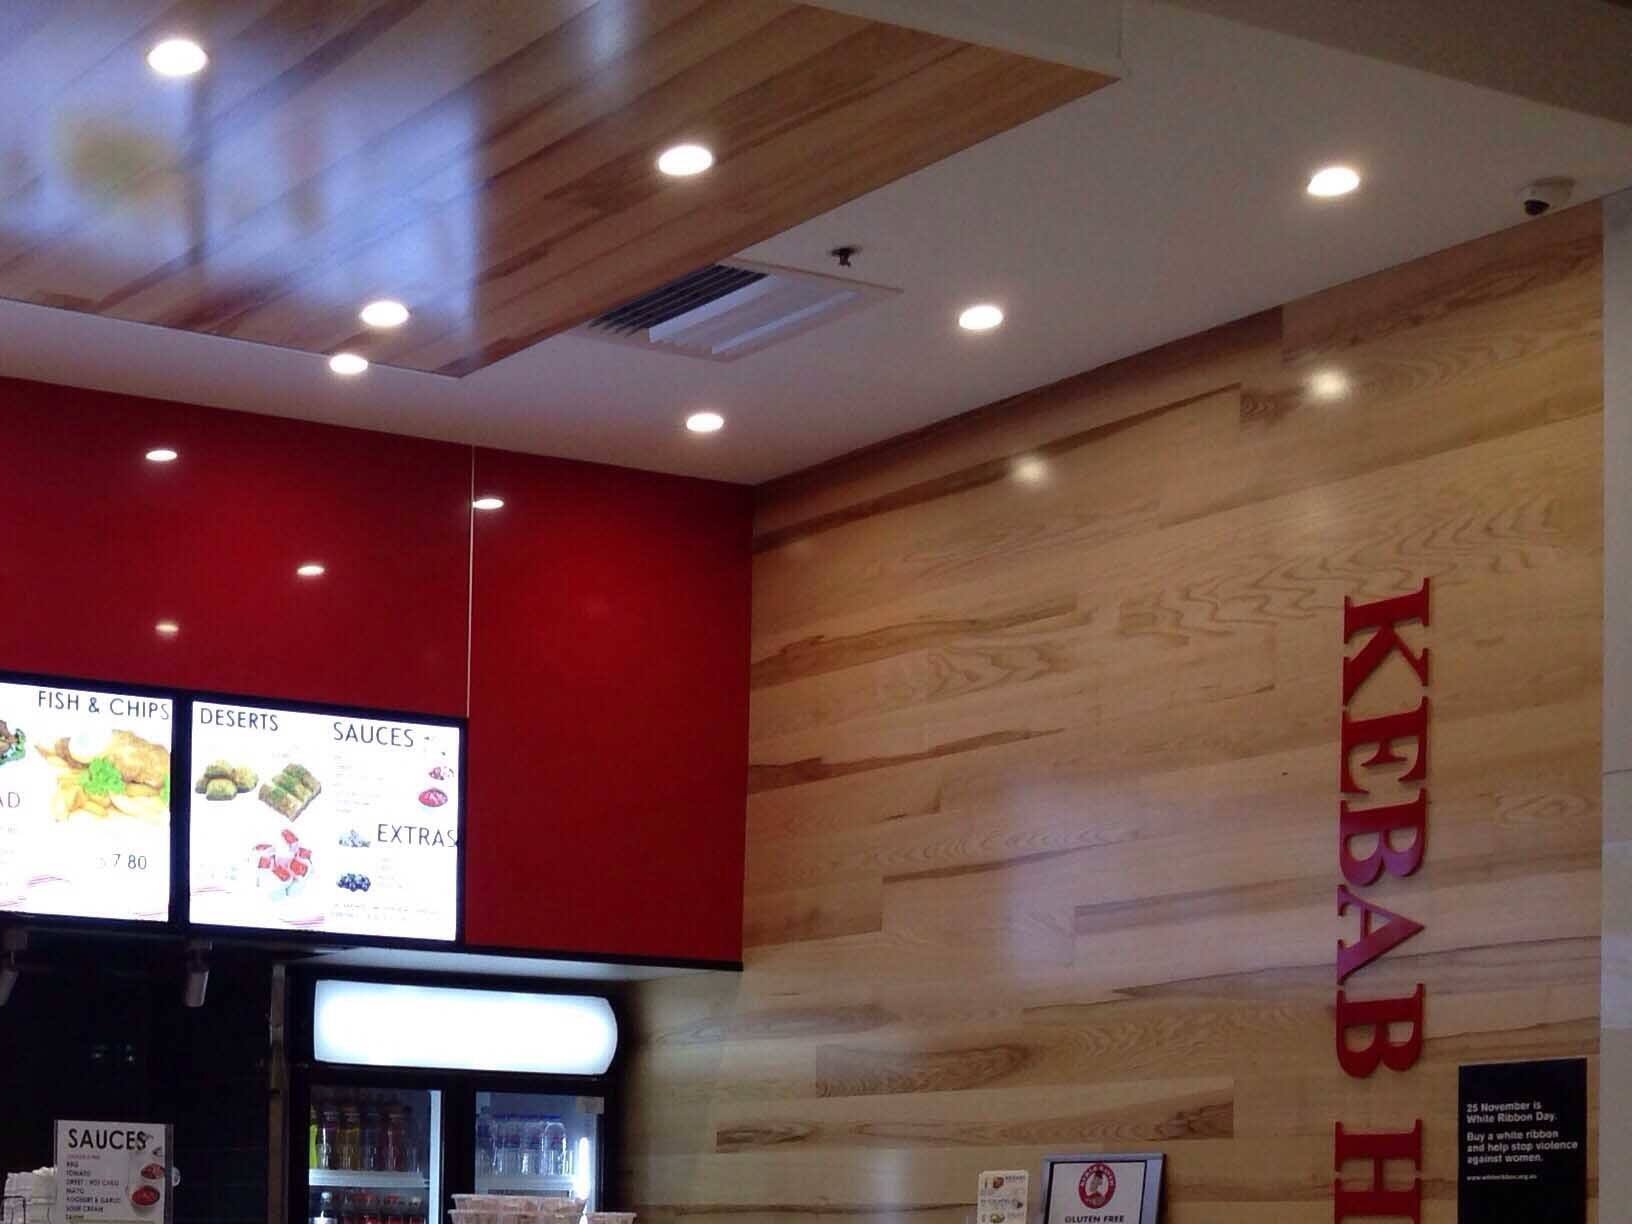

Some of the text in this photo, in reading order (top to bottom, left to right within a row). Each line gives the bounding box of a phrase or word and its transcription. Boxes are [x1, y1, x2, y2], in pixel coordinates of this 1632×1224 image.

[38, 690, 169, 721] FISH & CHIPS
[200, 707, 279, 732] DESERTS
[333, 721, 414, 748] SAUCES
[377, 823, 458, 848] EXTRAS
[1335, 577, 1430, 1079] KEBAB
[1466, 1101, 1542, 1112] 25 November is
[1466, 1114, 1494, 1123] White
[1497, 1112, 1533, 1122] Ribbon
[68, 1128, 146, 1151] SAUCES
[1466, 1132, 1485, 1142] Buy
[1496, 1131, 1523, 1140] white
[1526, 1129, 1559, 1139] ribbon
[1466, 1140, 1578, 1153] and help stop violence
[1466, 1154, 1503, 1165] against
[1065, 1215, 1125, 1224] GLUTEN FREE
